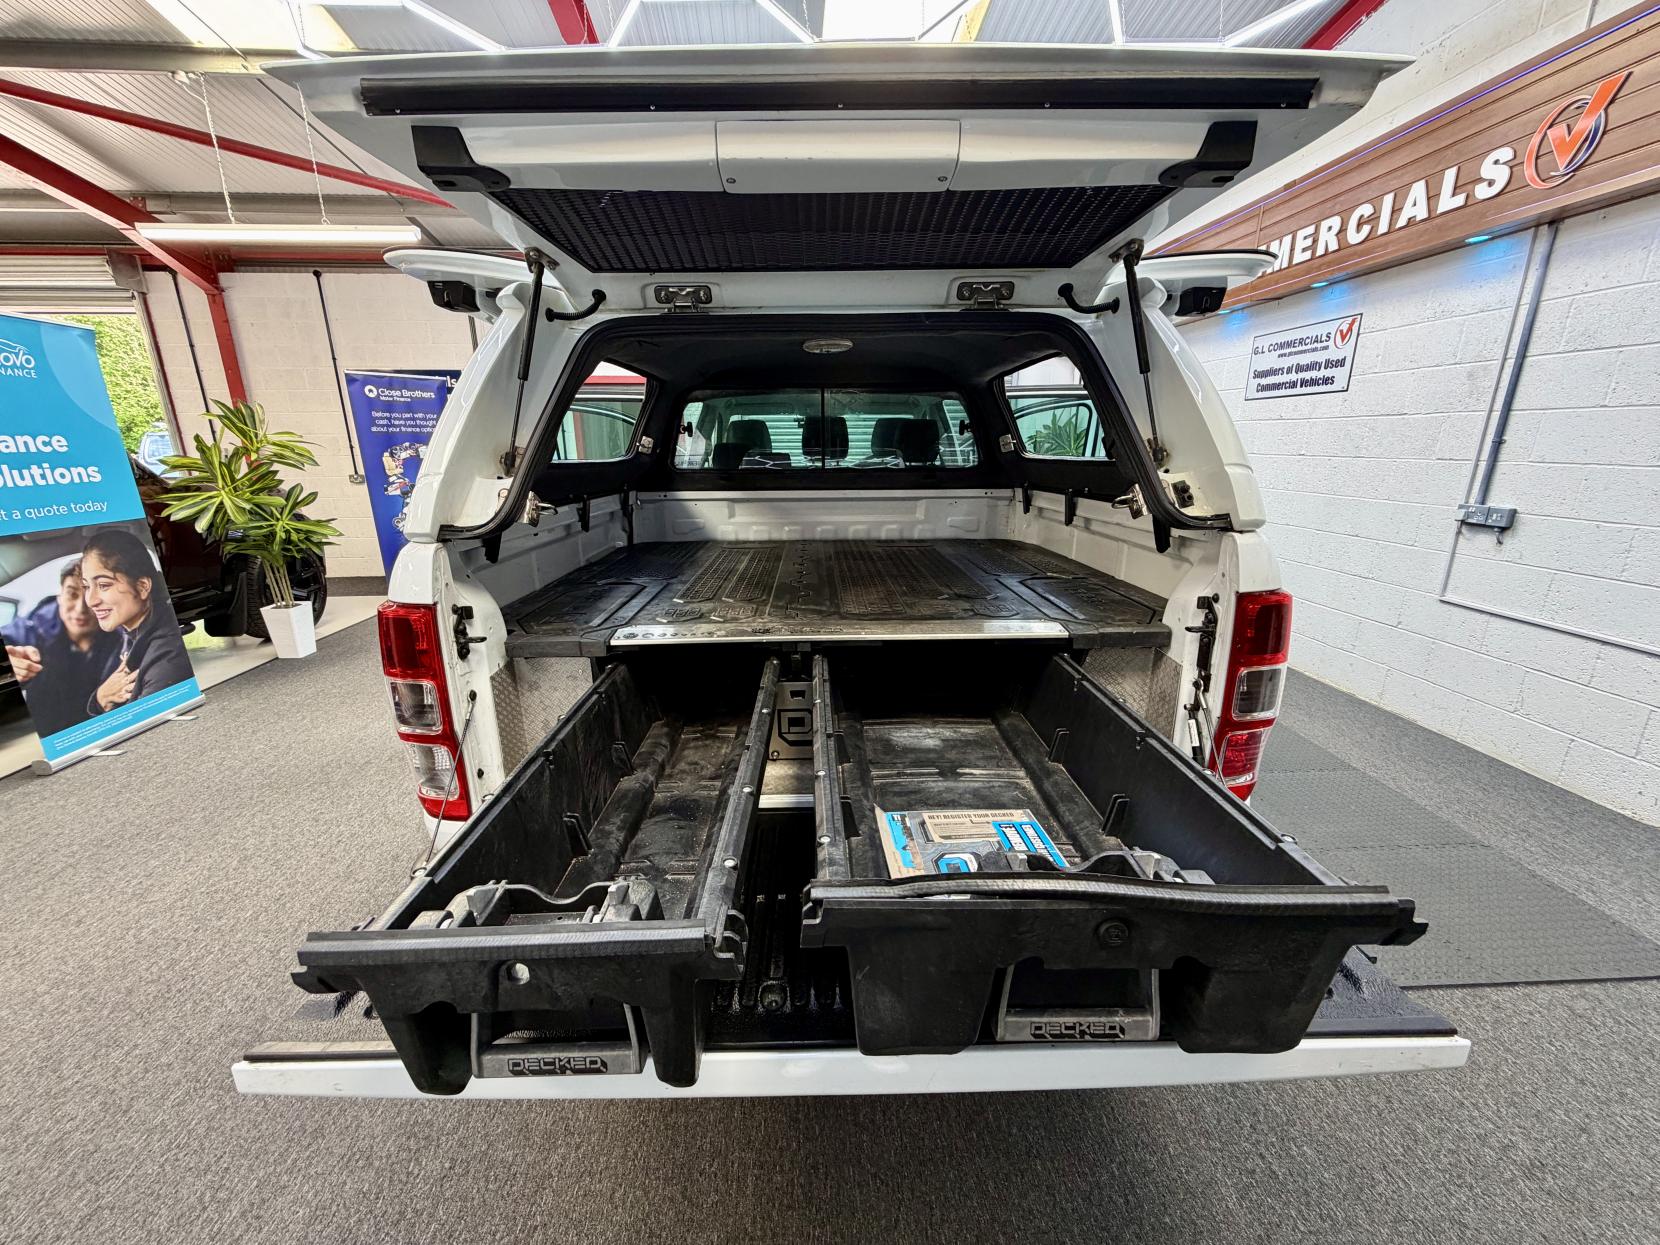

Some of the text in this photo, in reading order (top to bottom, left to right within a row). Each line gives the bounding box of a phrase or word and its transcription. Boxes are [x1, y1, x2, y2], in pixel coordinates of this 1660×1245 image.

[1256, 147, 1515, 276] MERCIALS
[1267, 332, 1332, 353] COMMERCIALS
[1252, 356, 1347, 379] Suppliers of Quality Used
[378, 388, 435, 398] Close Brothers
[1256, 375, 1336, 393] Commercial Vehicles
[0, 463, 102, 488] lutions
[12, 510, 21, 520] a
[25, 504, 68, 520] quote
[70, 500, 108, 514] today
[1030, 1021, 1123, 1037] DECKED
[508, 1056, 606, 1074] DECKED
